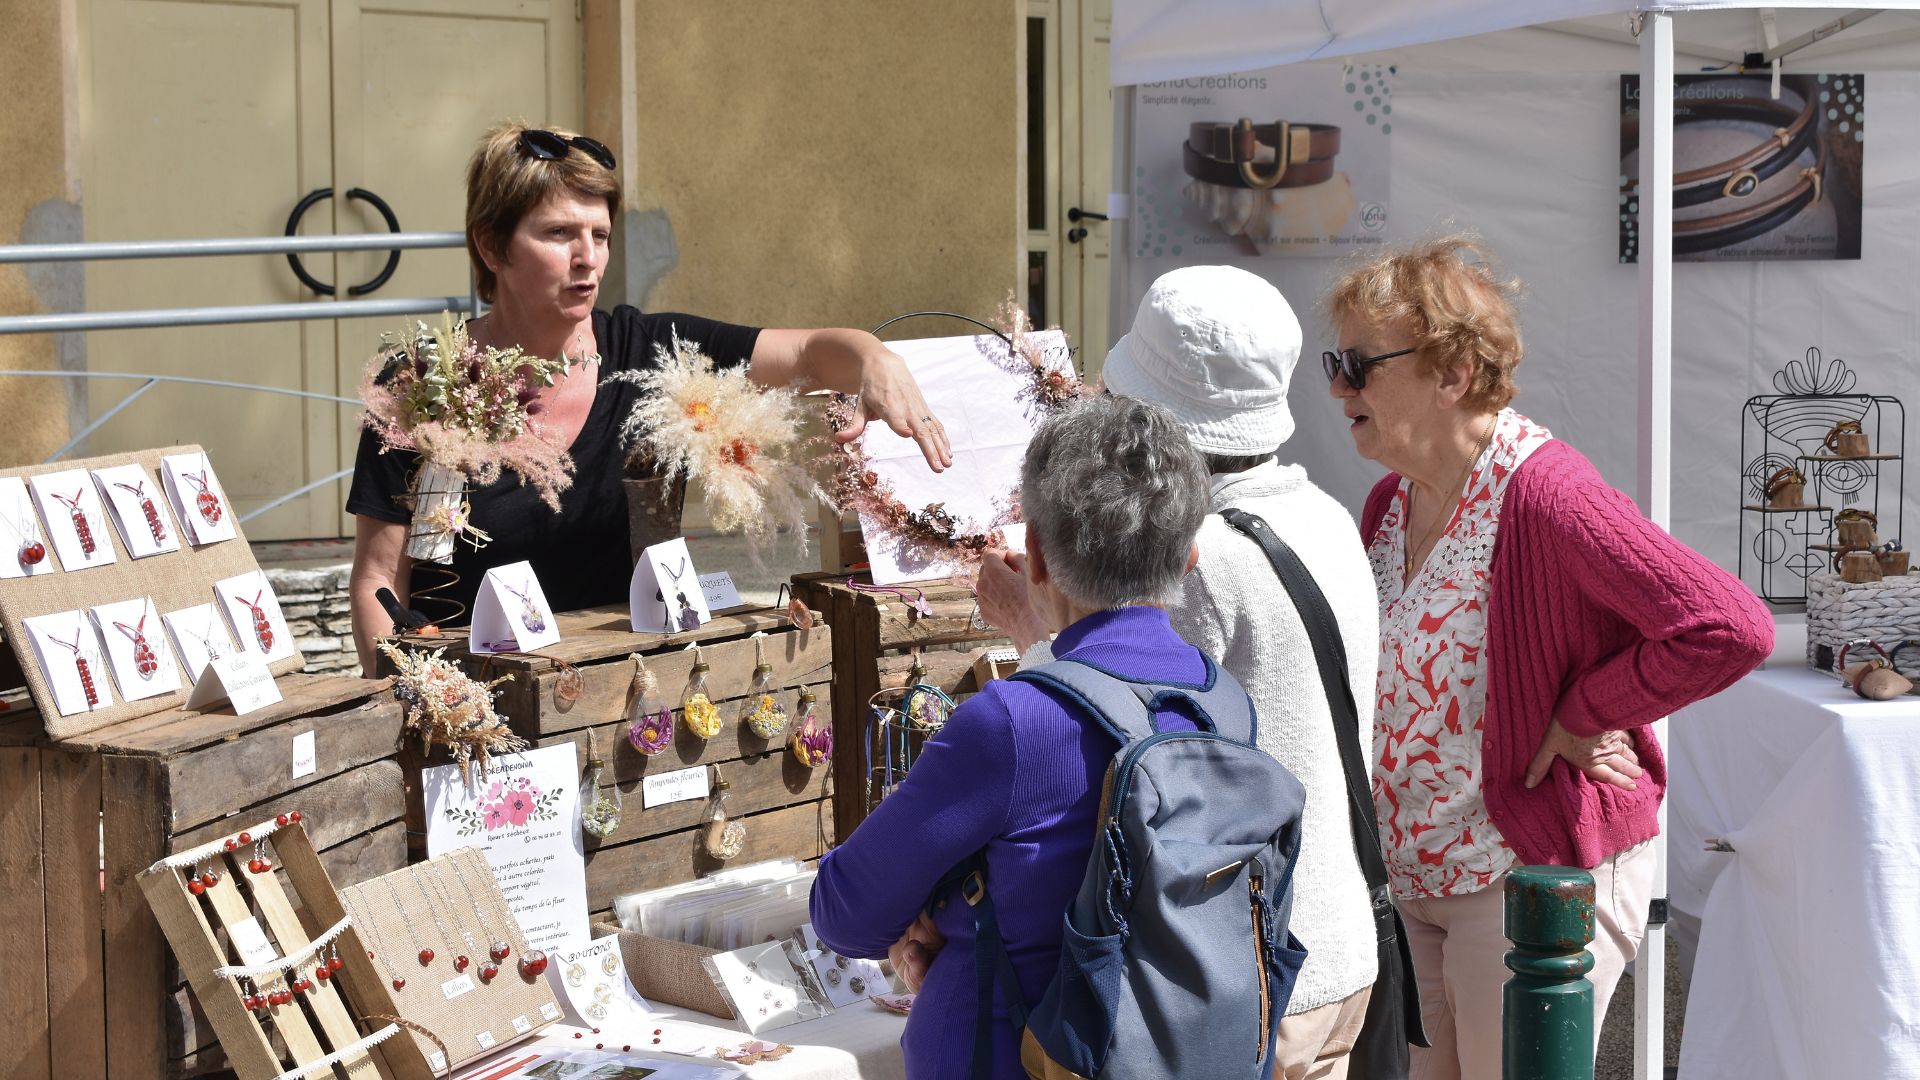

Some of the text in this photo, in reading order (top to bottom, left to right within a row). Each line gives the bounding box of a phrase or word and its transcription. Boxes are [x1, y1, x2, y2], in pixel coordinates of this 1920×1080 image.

[498, 860, 519, 873] parfois
[508, 872, 523, 880] autre
[501, 884, 520, 895] upport
[522, 903, 538, 915] temps
[538, 900, 545, 908] de
[552, 896, 565, 909] fleur
[568, 940, 612, 962] BOUTONS
